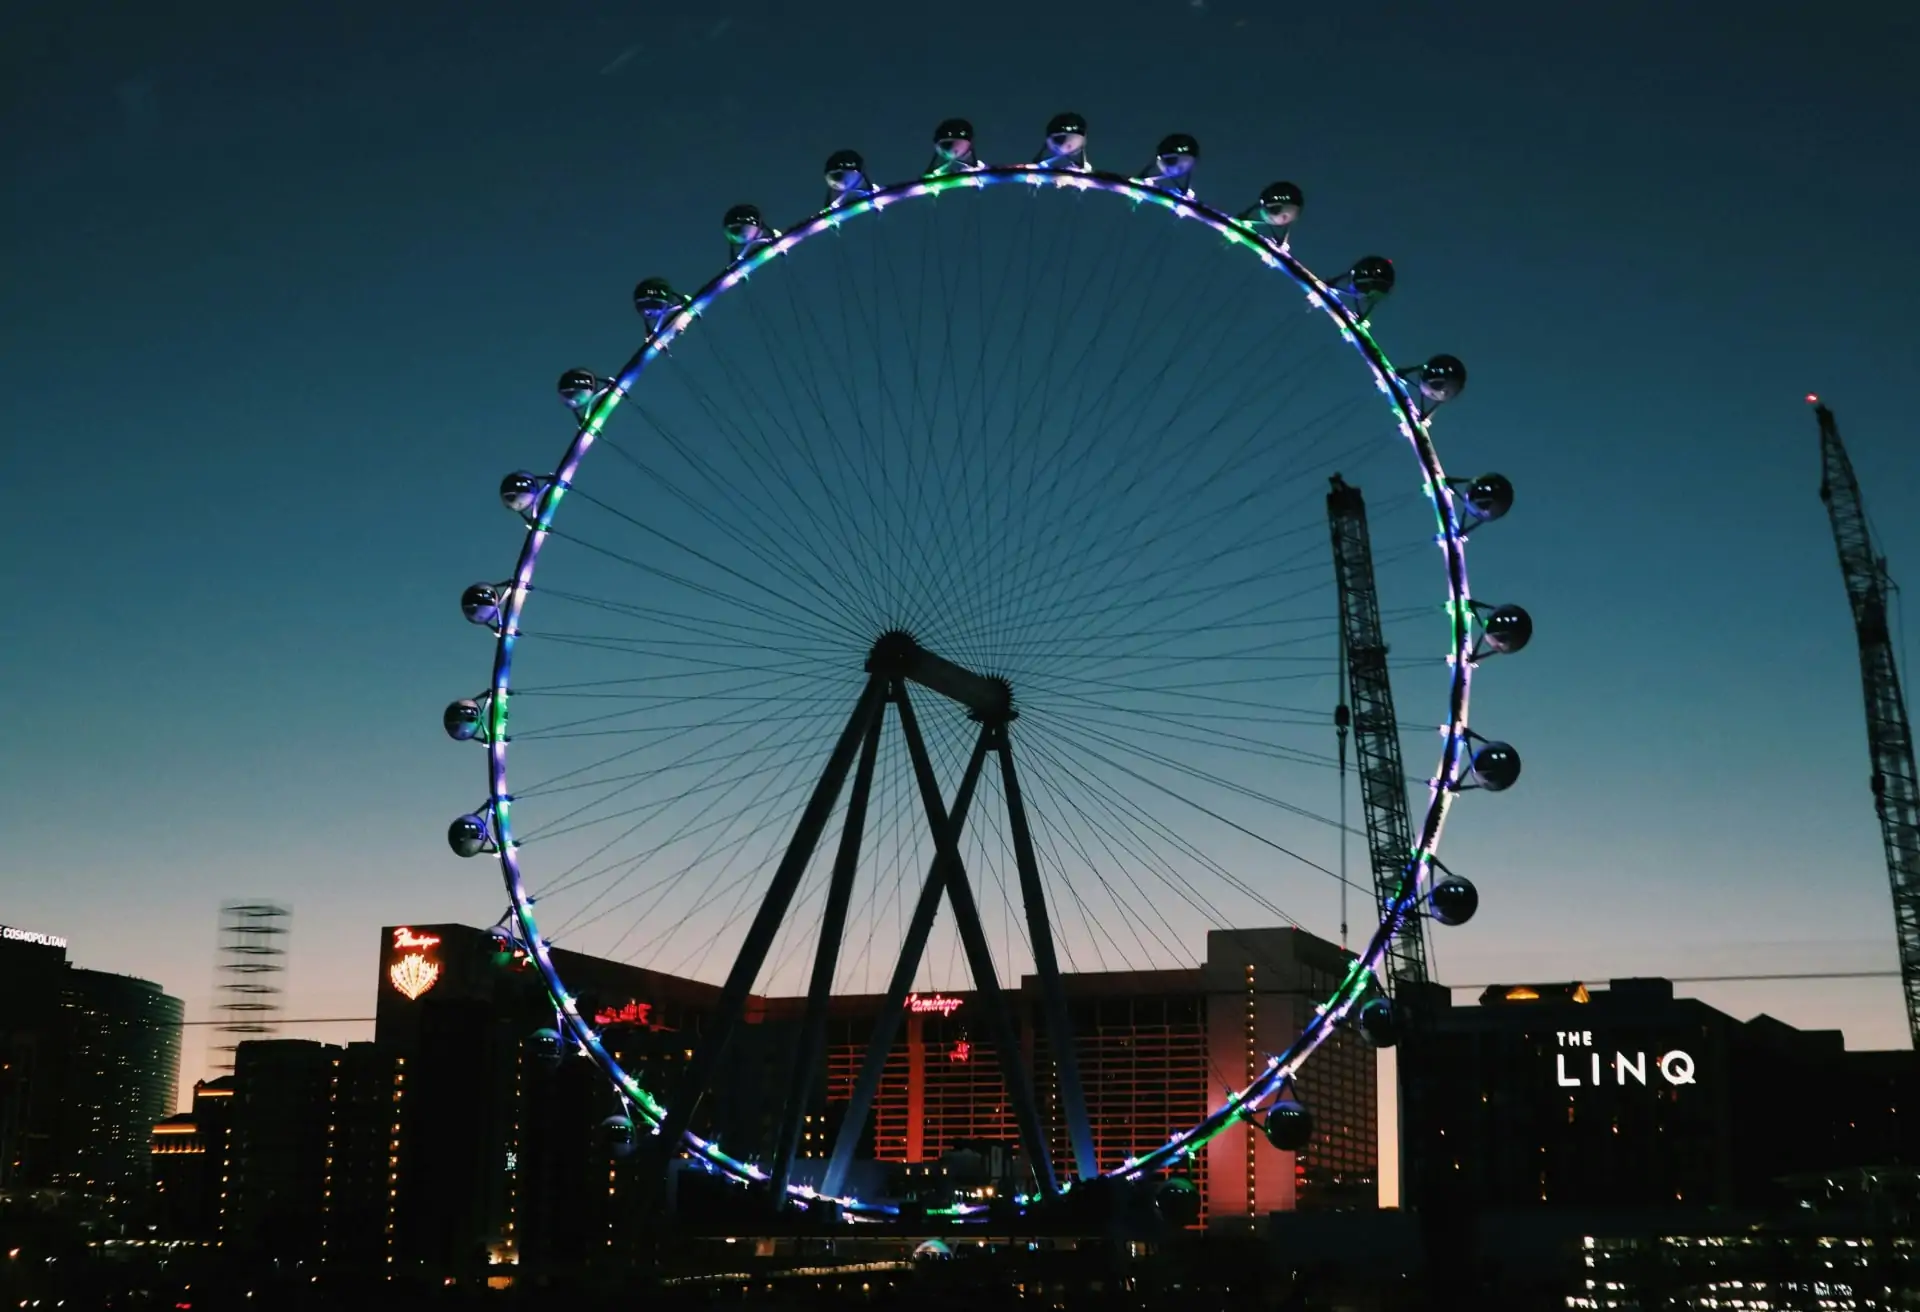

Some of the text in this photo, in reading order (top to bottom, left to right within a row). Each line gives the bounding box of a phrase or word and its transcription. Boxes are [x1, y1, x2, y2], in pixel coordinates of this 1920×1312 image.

[3, 927, 67, 948] COSMOPOLITAN
[1556, 1031, 1592, 1047] THE
[1557, 1050, 1696, 1086] LINQ
